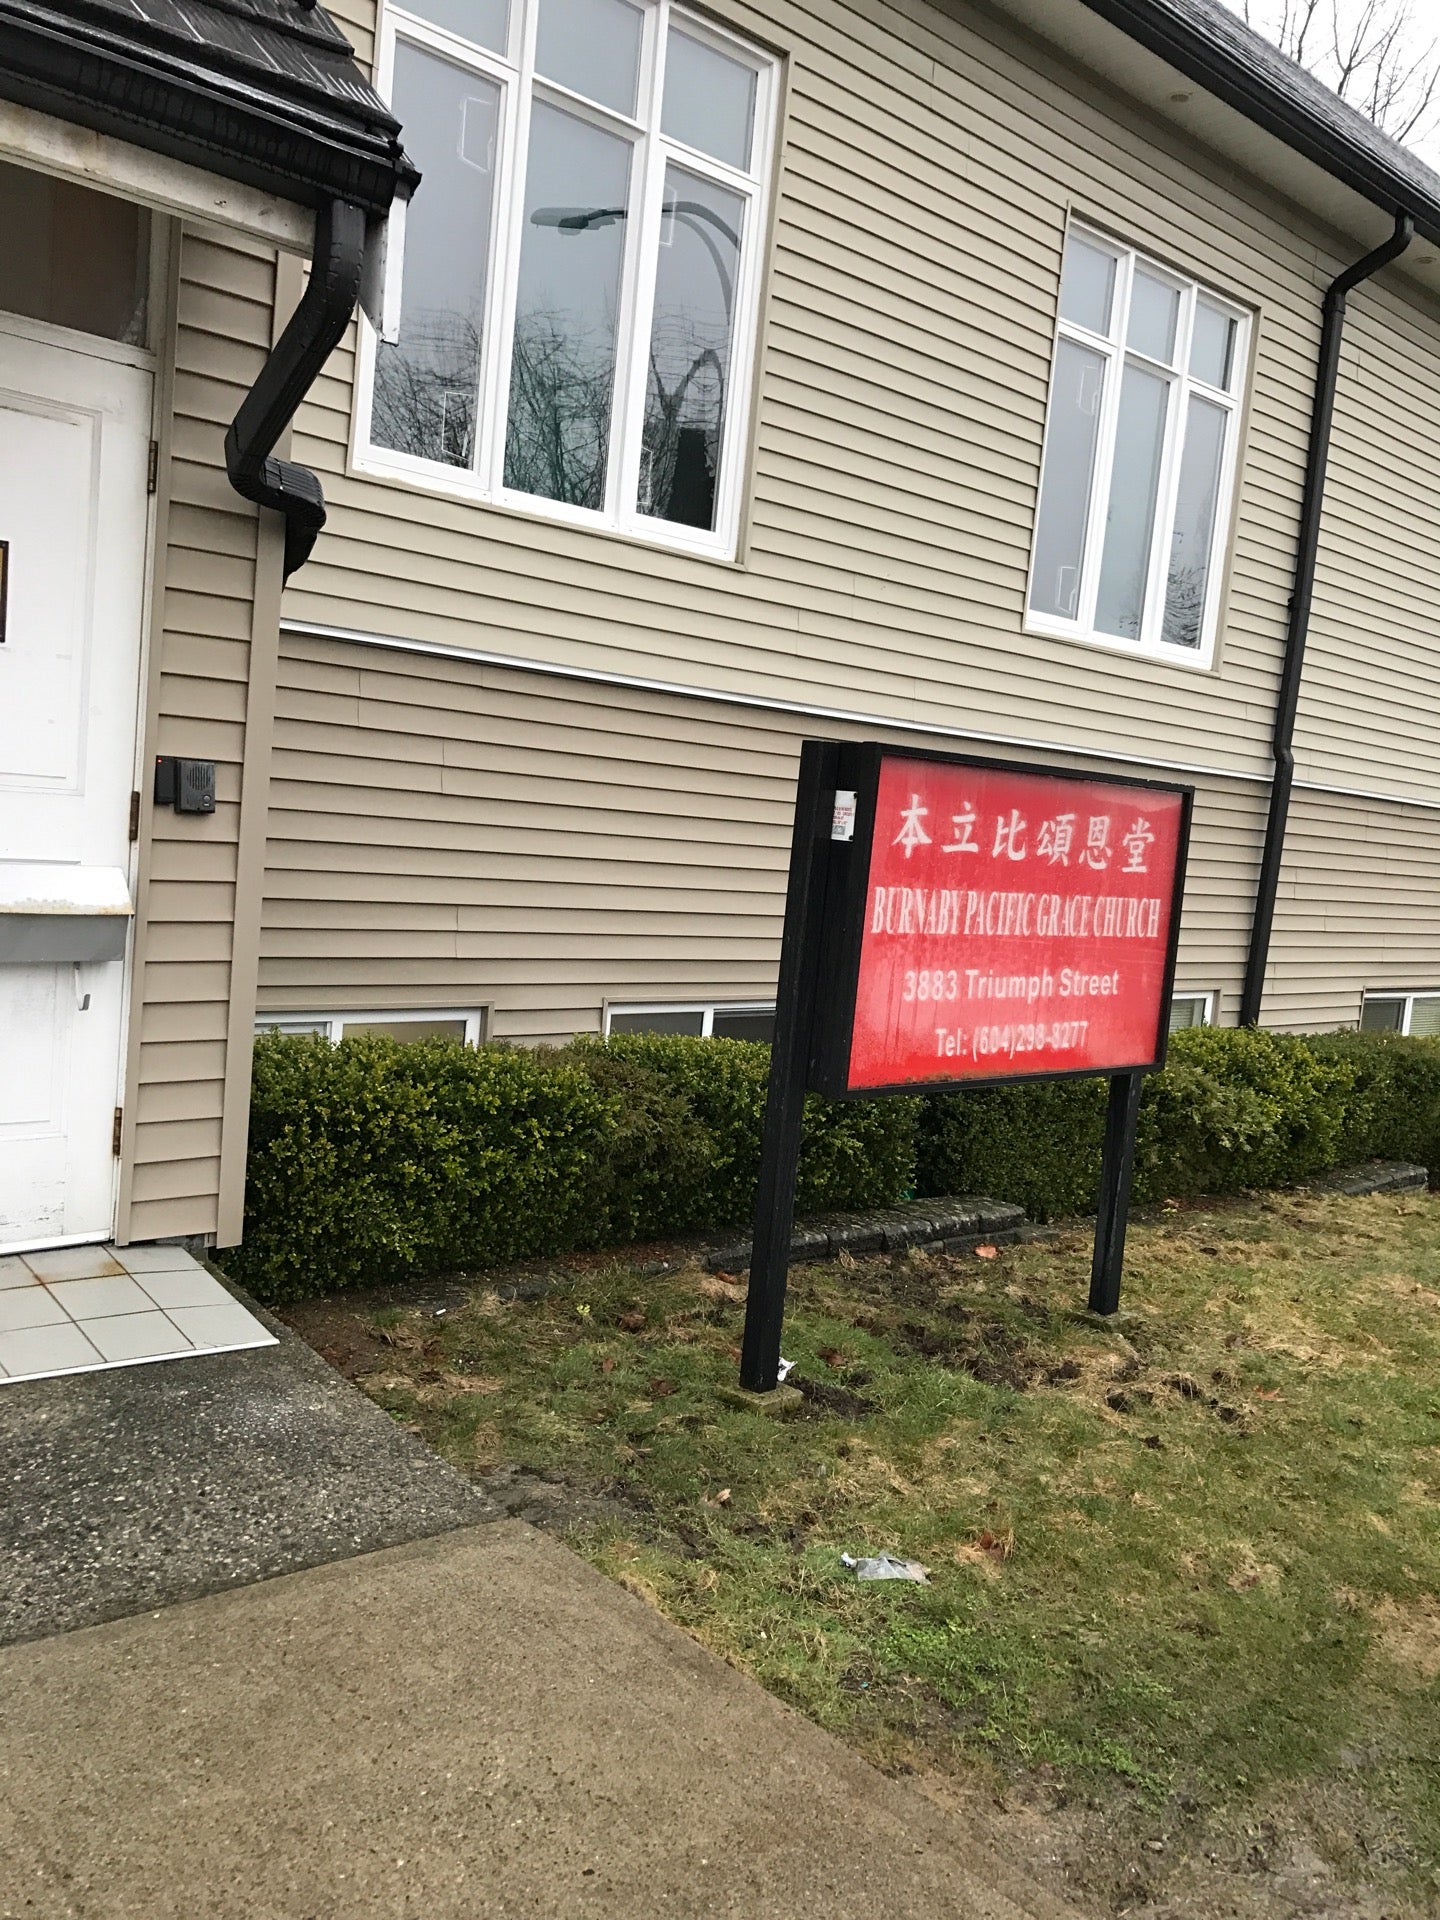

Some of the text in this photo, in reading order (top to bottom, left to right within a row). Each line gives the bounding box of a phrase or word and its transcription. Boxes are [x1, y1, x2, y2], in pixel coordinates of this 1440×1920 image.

[891, 793, 1155, 874] 本立比頌恩堂
[871, 886, 1161, 938] BURNABY PACIFIC GRACE CHURCH
[903, 967, 1119, 1004] 3883 Triumph Street
[935, 1027, 967, 1057] Tel:
